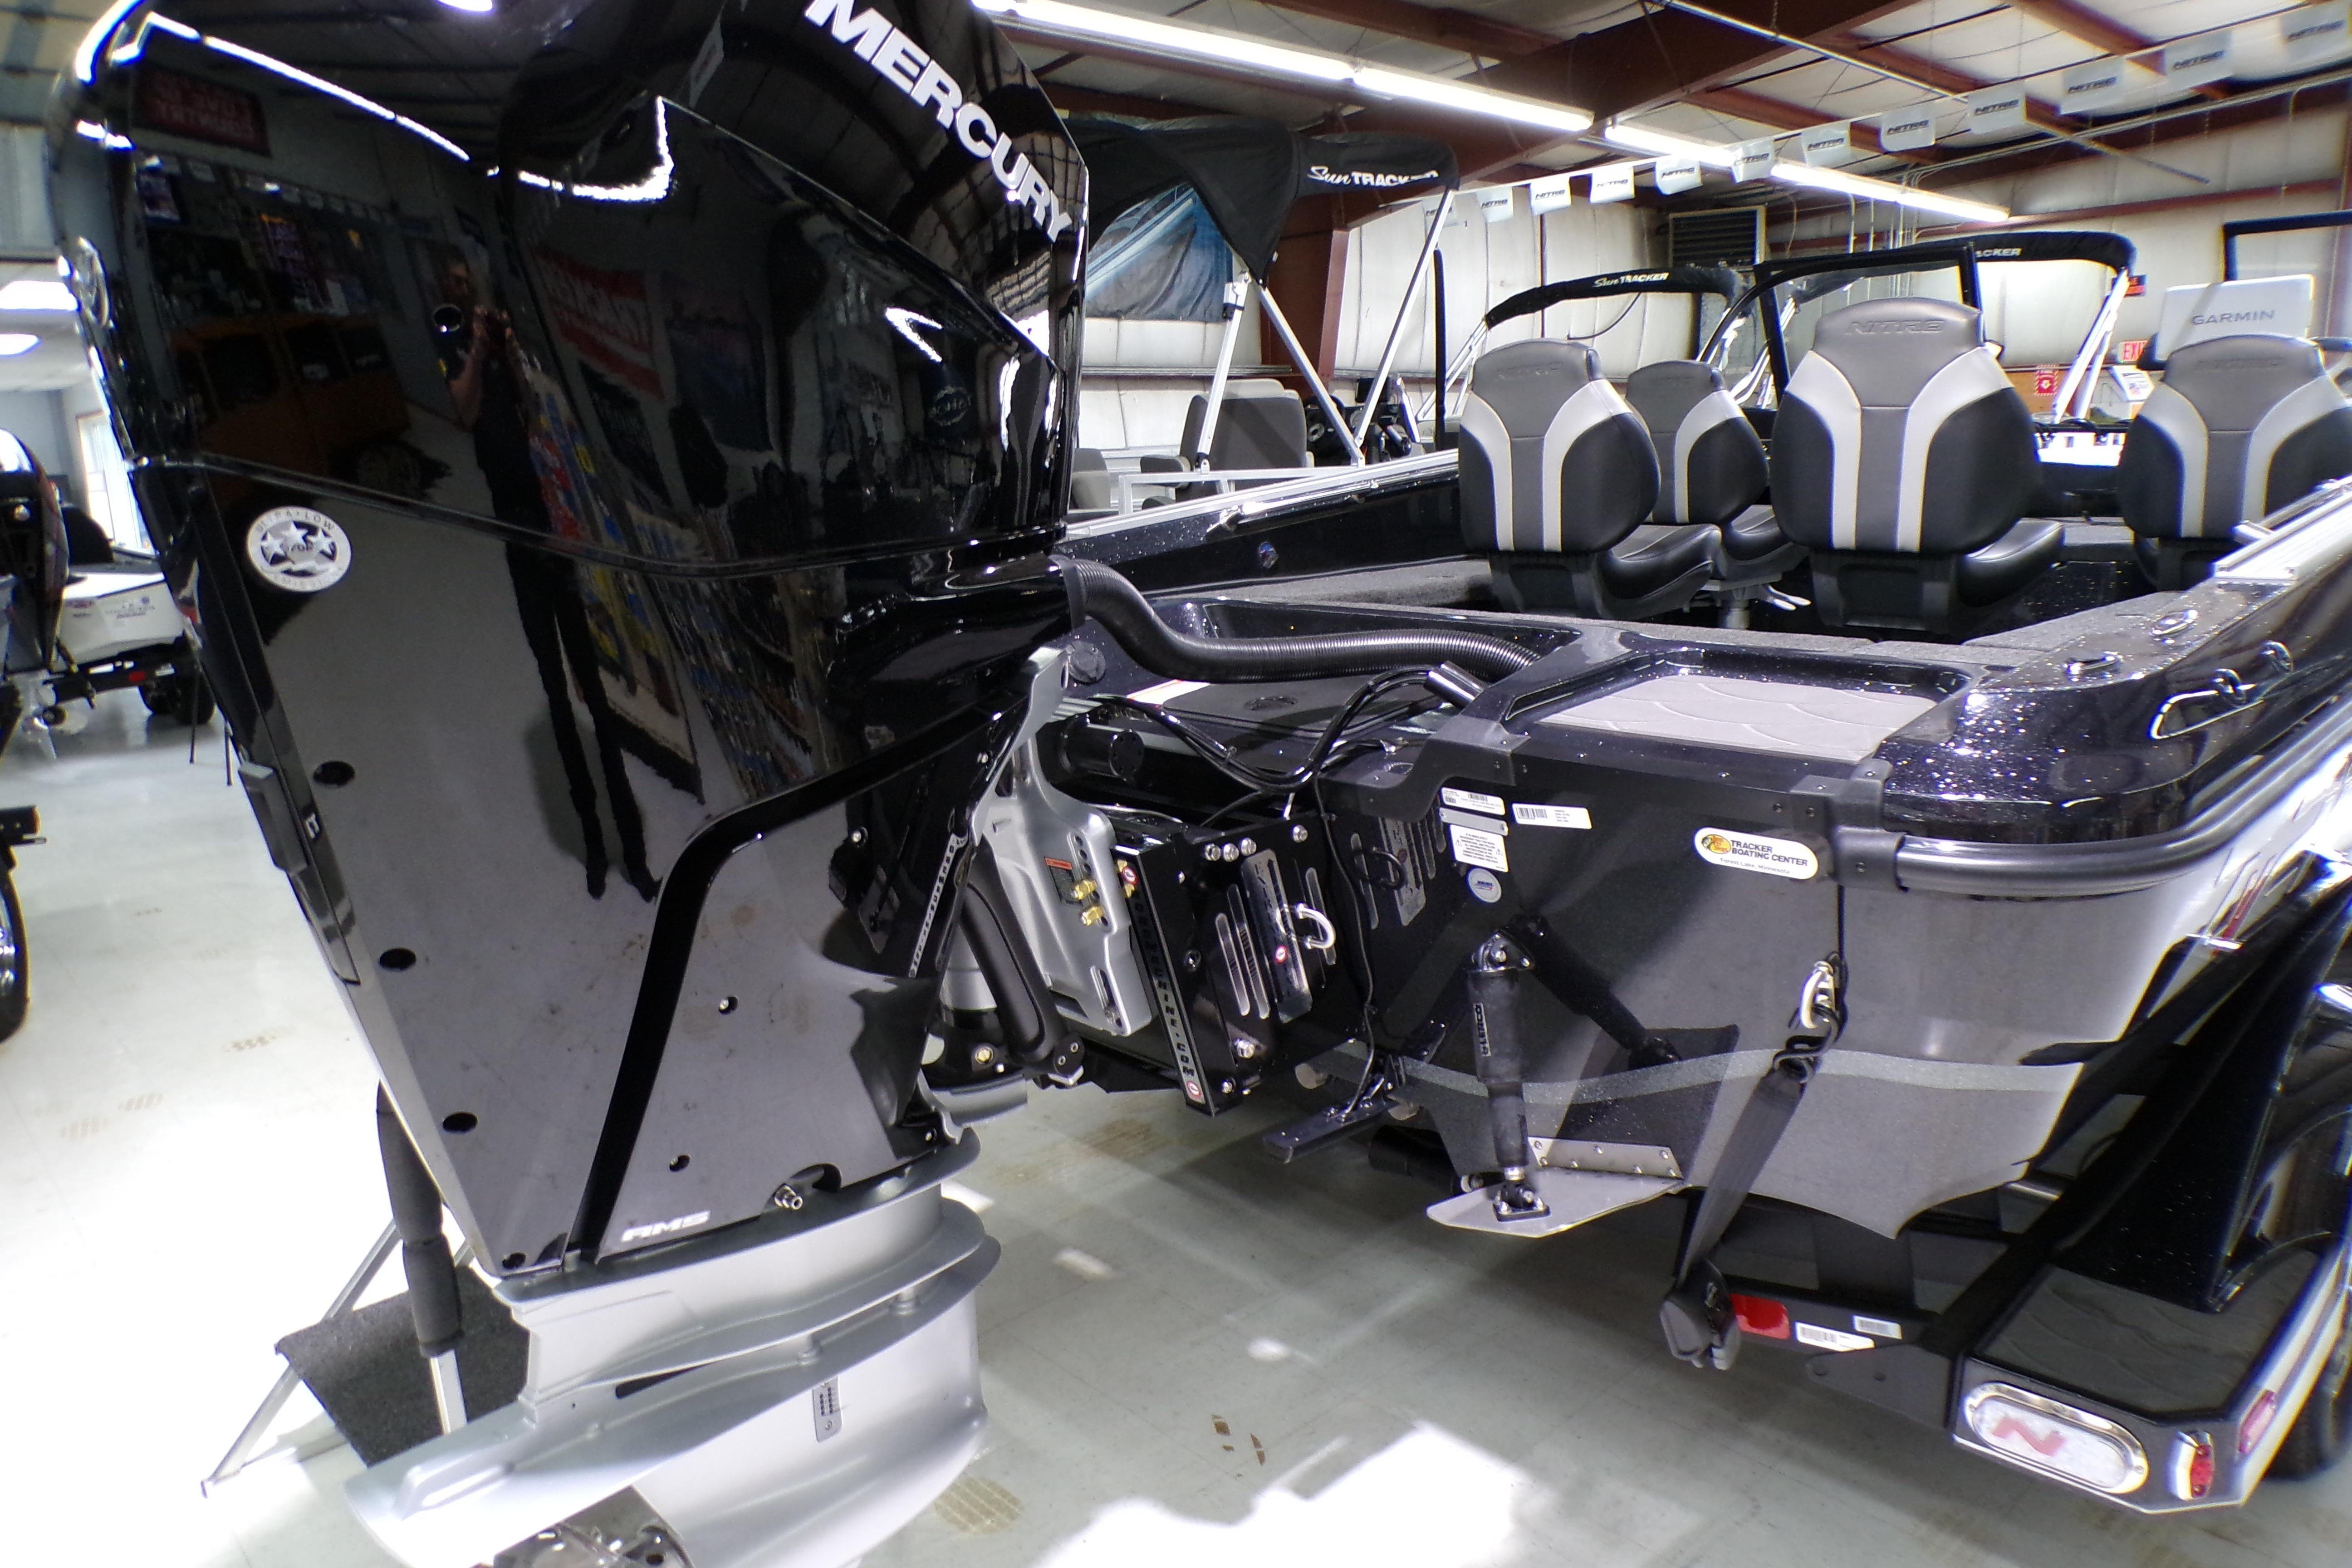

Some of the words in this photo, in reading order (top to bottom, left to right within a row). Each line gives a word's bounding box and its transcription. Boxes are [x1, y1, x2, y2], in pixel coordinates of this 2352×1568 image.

[805, 0, 1072, 243] MERCURY
[1661, 167, 1695, 179] NITRO
[1535, 189, 1565, 200] NITRO
[1481, 199, 1508, 209] NITRO
[2192, 309, 2275, 325] GARMIN
[1845, 319, 1945, 335] NITRO
[1731, 840, 1773, 853] TRACKER
[1732, 848, 1769, 859] BOATING
[1771, 854, 1808, 866] CENTER
